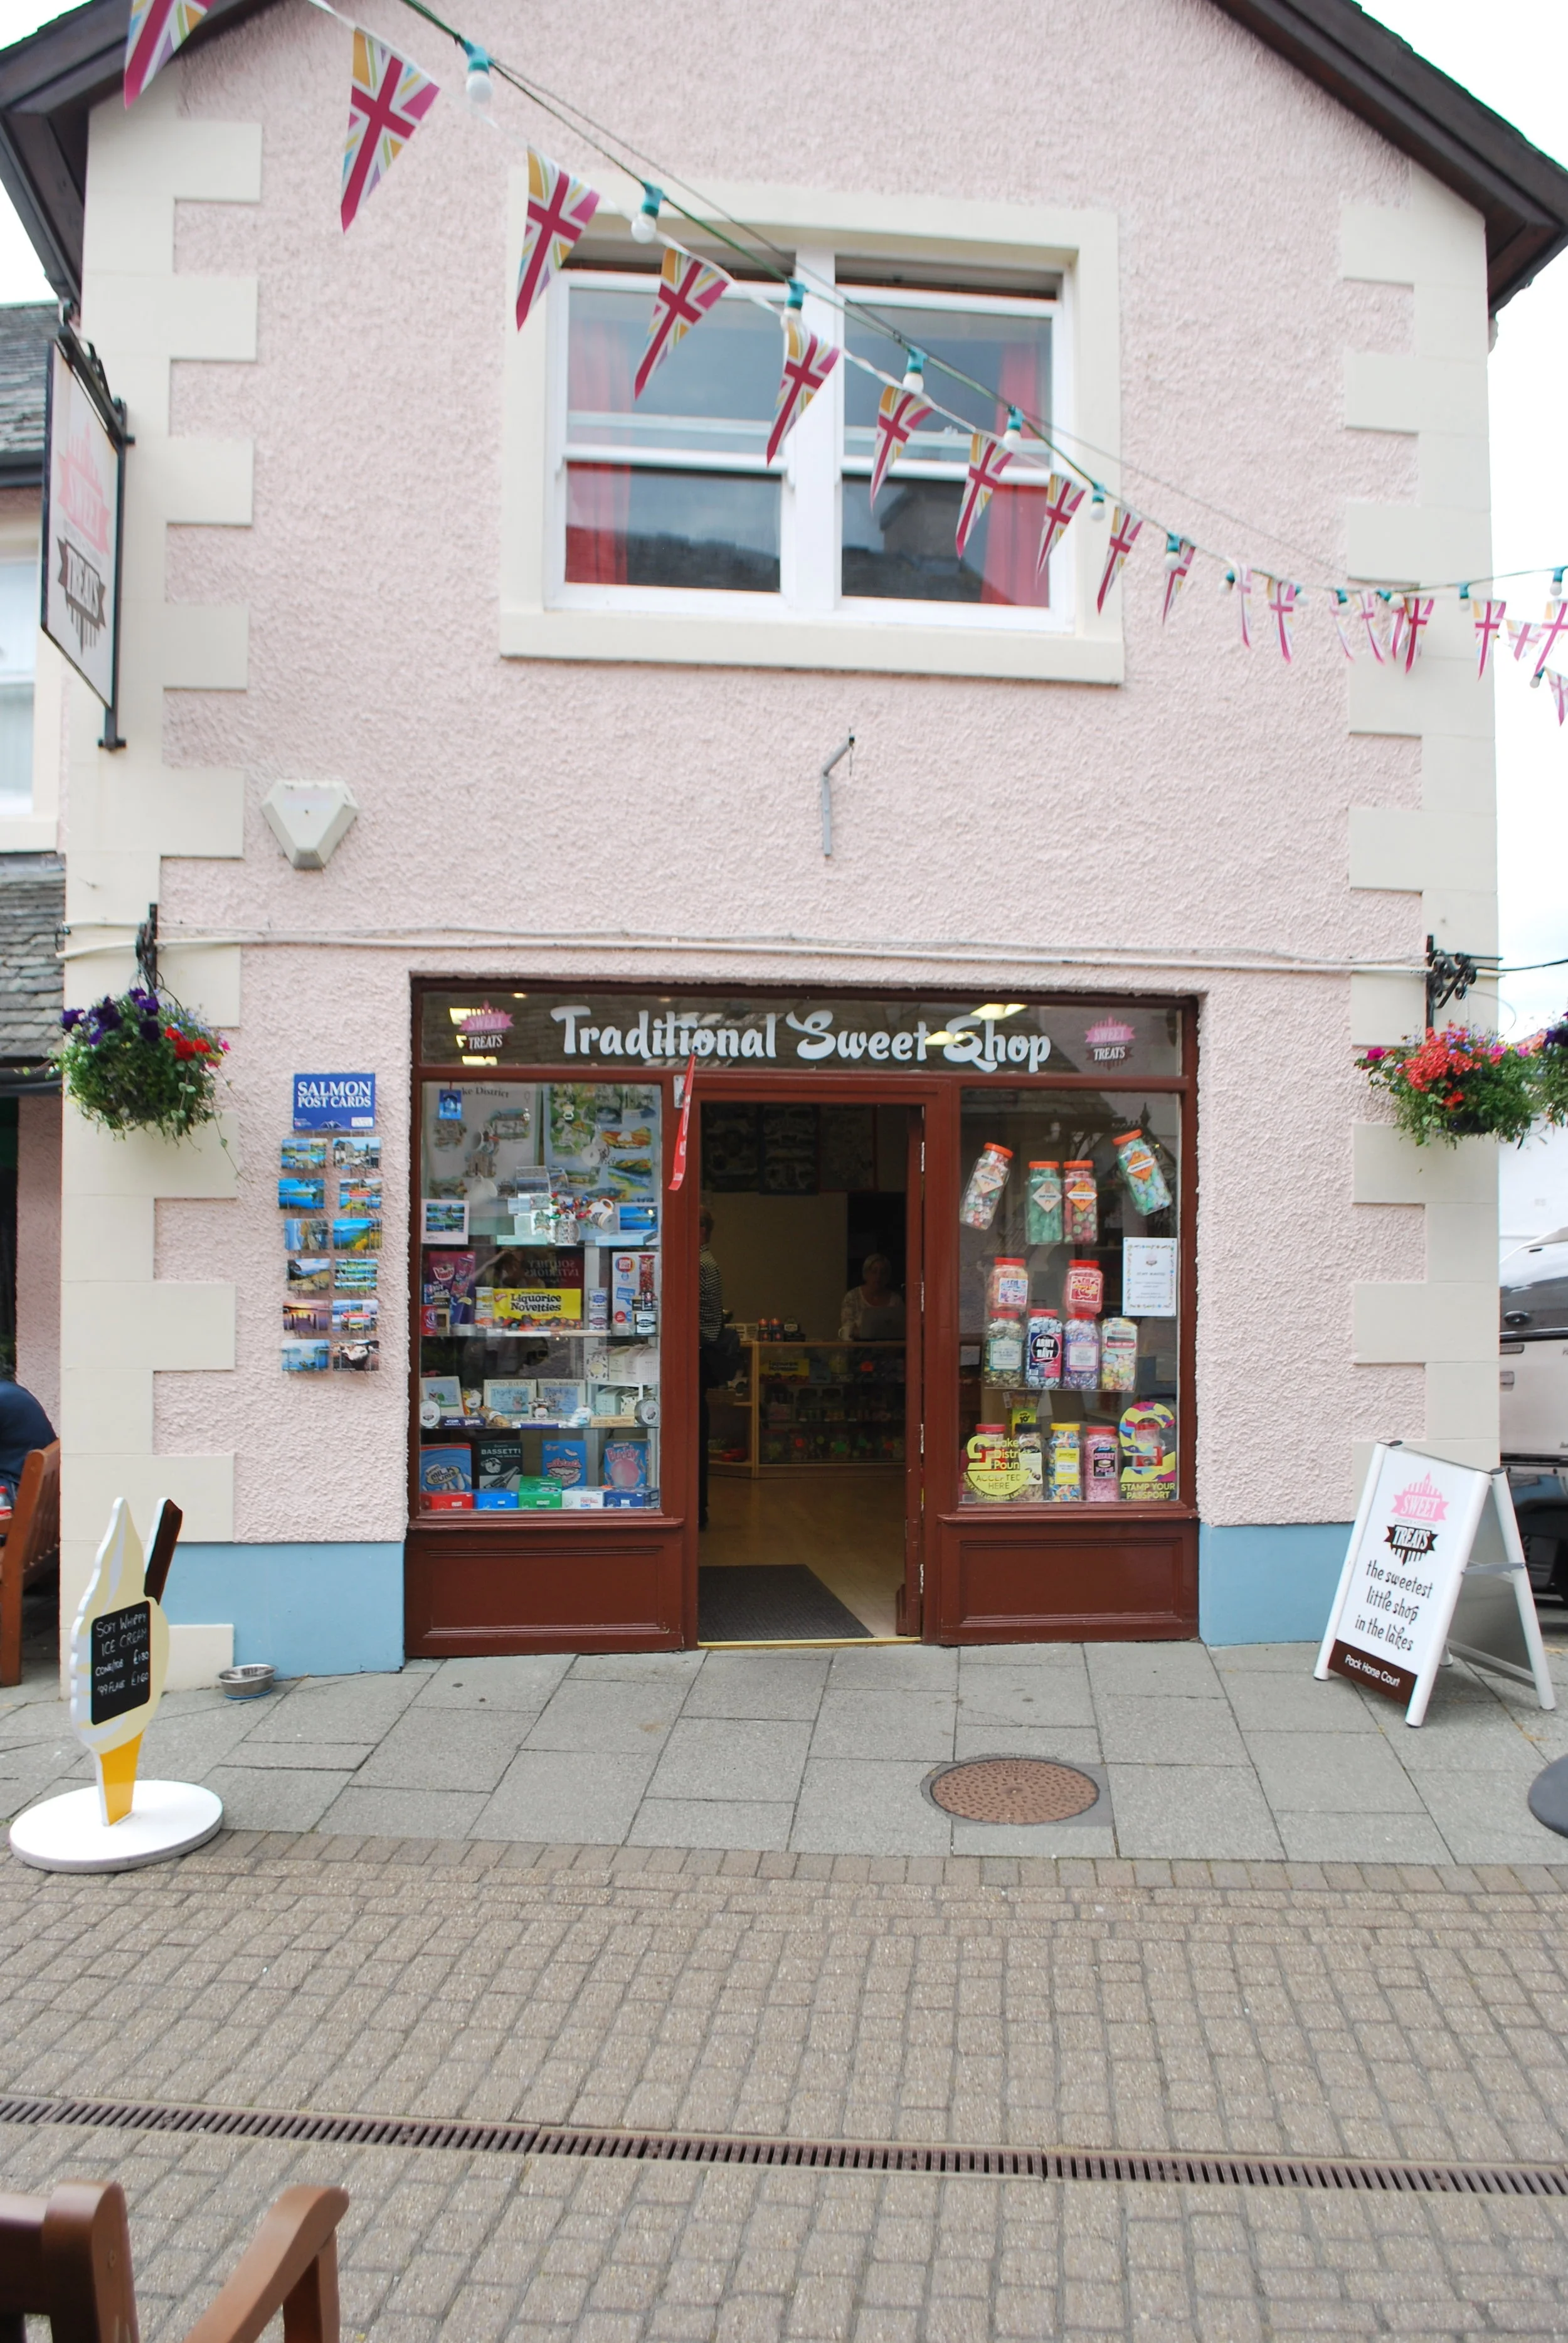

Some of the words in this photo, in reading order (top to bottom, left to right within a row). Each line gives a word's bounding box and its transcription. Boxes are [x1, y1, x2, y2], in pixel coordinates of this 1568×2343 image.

[66, 545, 99, 619] TREATS
[468, 1015, 502, 1030] SWEET
[469, 1034, 503, 1050] TREATS
[551, 1005, 776, 1060] Traditional
[786, 1009, 928, 1062] Sweet
[943, 1016, 1051, 1073] Shop
[1092, 1026, 1126, 1043] SWEET
[1093, 1046, 1126, 1061] TREATS
[297, 1081, 372, 1097] SALMON
[475, 1086, 509, 1098] District
[297, 1096, 329, 1108] POST
[330, 1096, 372, 1108] CARDS
[511, 1294, 561, 1306] Liquorice
[511, 1302, 561, 1312] Novelties
[1036, 1338, 1055, 1347] ARMY
[1036, 1348, 1054, 1358] NAVY
[994, 1437, 1019, 1447] Lake
[1121, 1484, 1150, 1492] STAMP
[1152, 1483, 1175, 1491] YOUR
[1126, 1491, 1170, 1499] PASSPORT
[1400, 1494, 1441, 1518] SWEET
[1392, 1526, 1431, 1550] TREATS
[1365, 1559, 1384, 1580] the
[1385, 1571, 1433, 1599] sweetest
[1366, 1585, 1392, 1612] little
[1392, 1598, 1419, 1625] shop
[120, 1613, 147, 1630] WHIPPY
[1355, 1614, 1366, 1632] in
[1367, 1617, 1384, 1639] the
[1385, 1623, 1414, 1651] lakes
[102, 1639, 116, 1657] ICE
[119, 1627, 147, 1648] CREAM
[1345, 1654, 1362, 1670] Pack
[1361, 1660, 1380, 1679] Horse
[1380, 1671, 1401, 1687] Court
